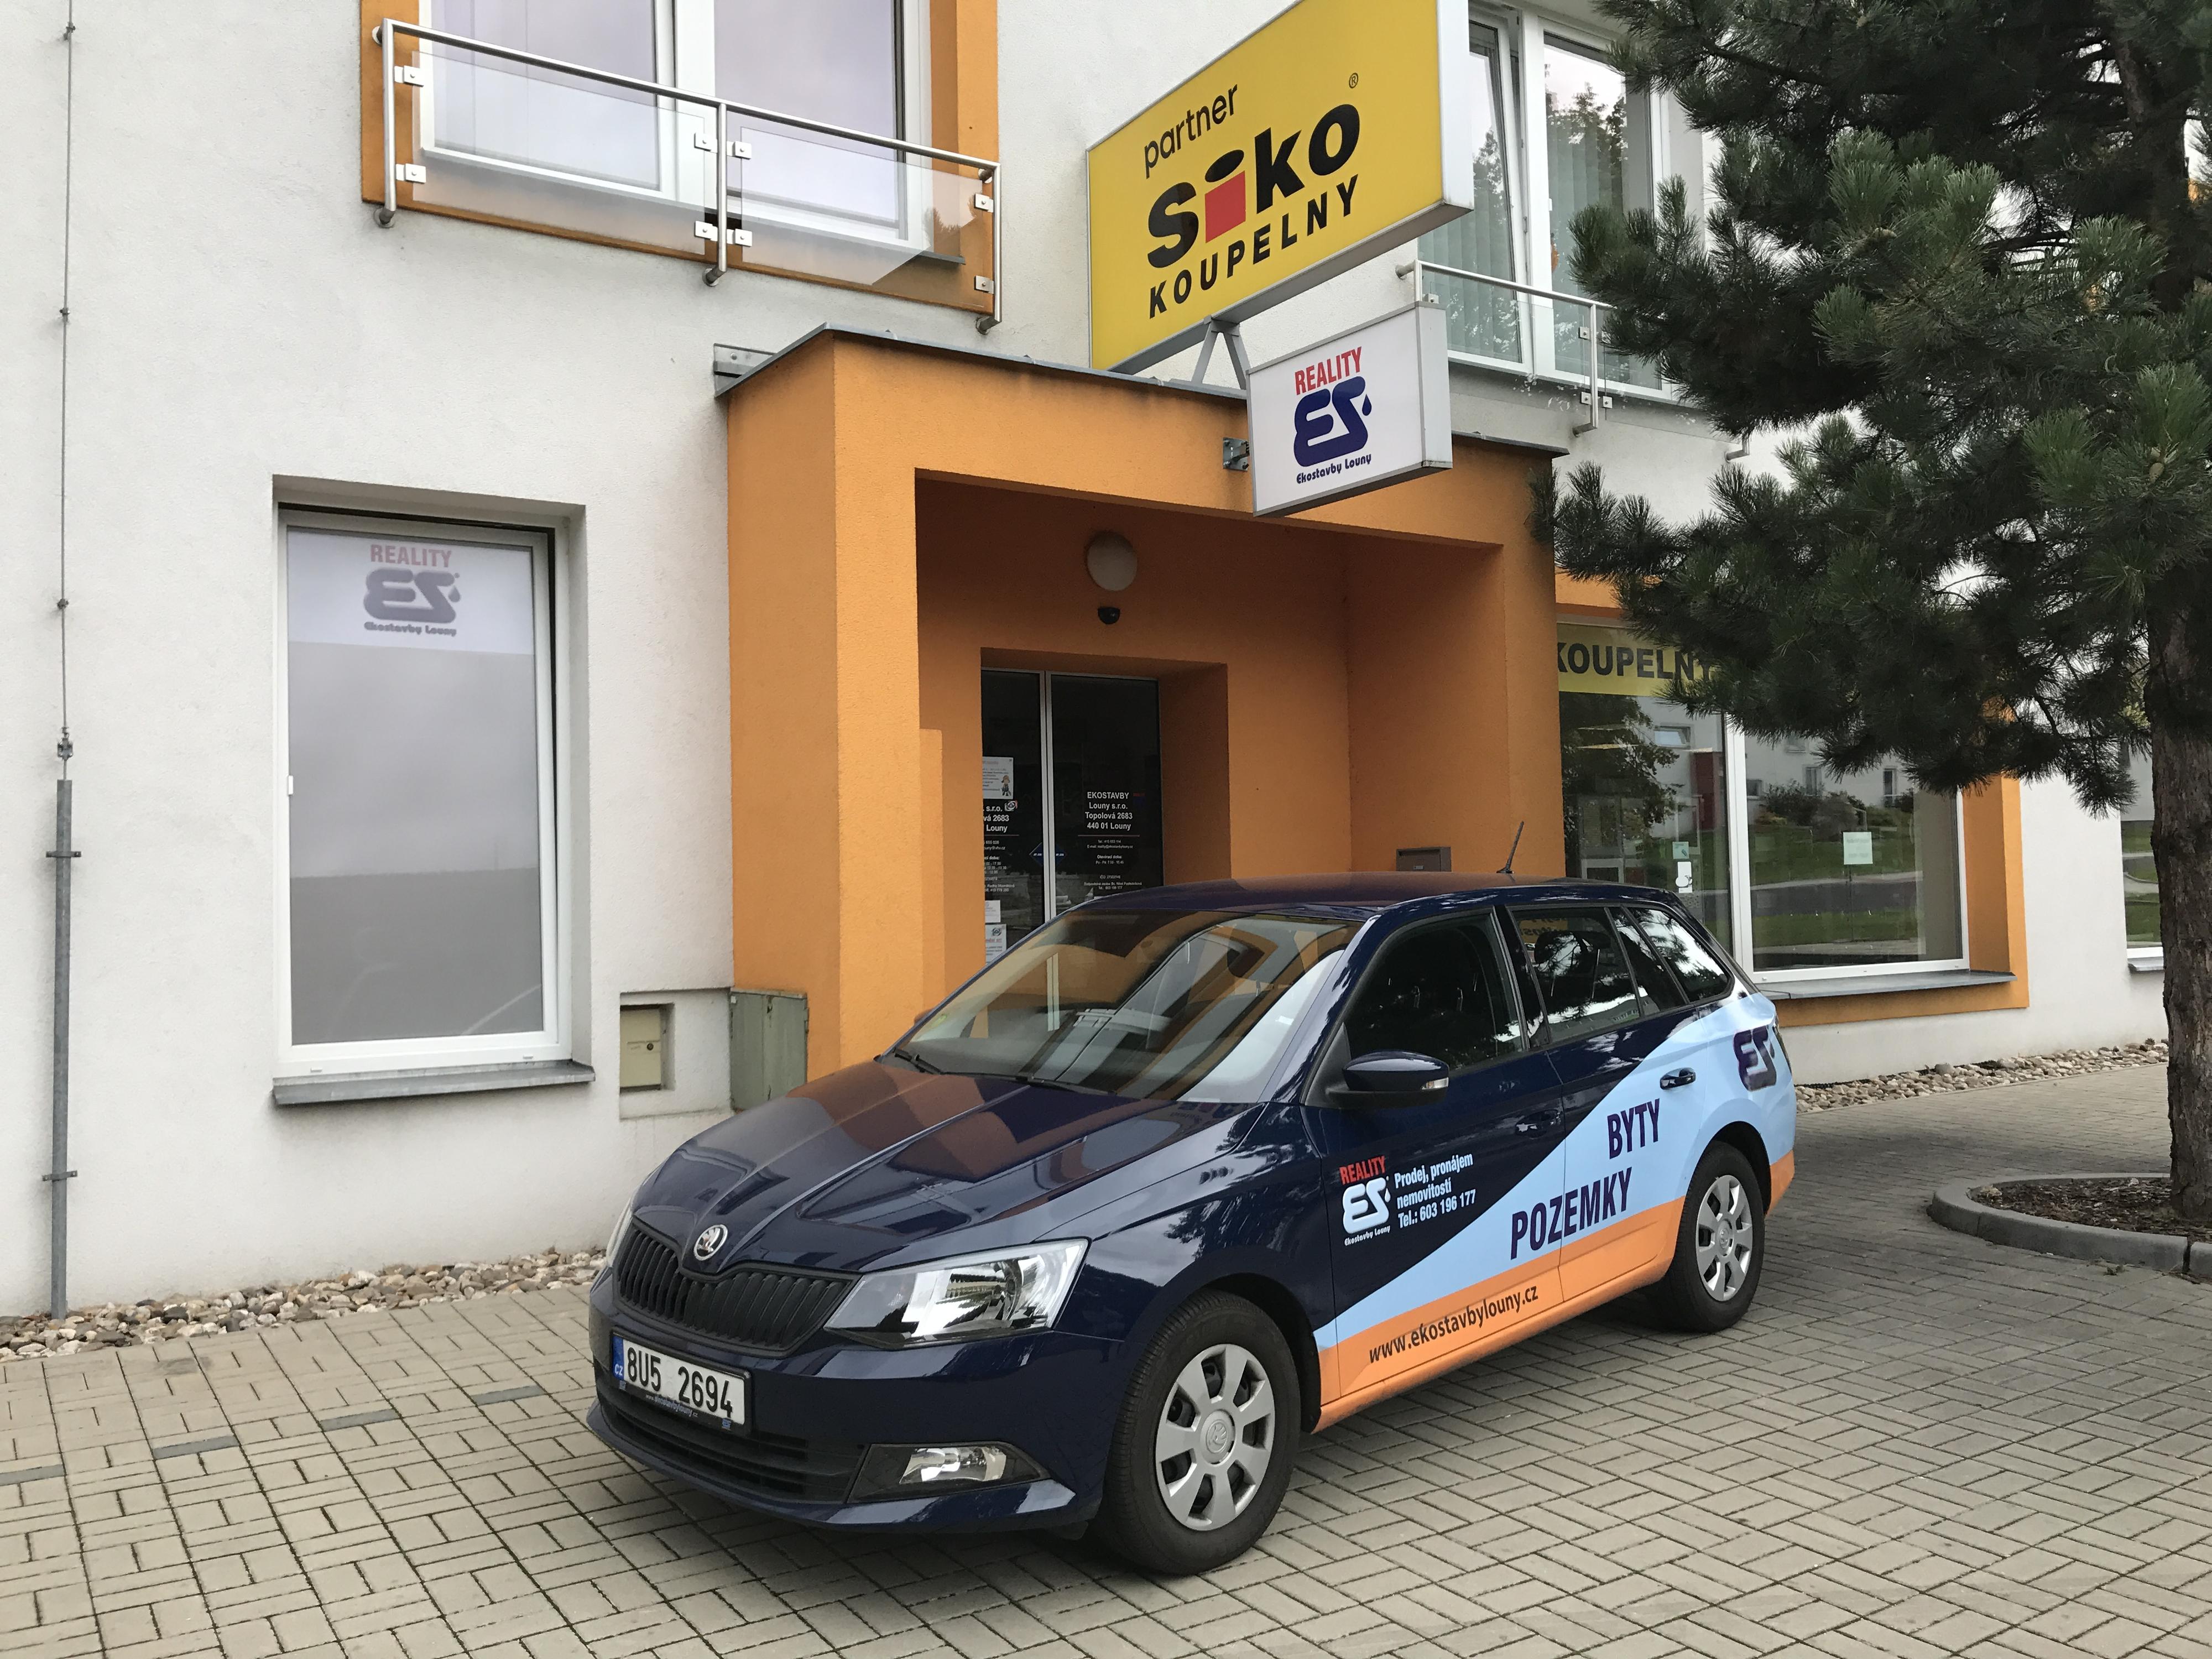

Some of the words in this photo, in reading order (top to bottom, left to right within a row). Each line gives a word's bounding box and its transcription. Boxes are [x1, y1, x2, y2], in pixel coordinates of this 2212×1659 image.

[1144, 85, 1238, 178] partner
[1149, 174, 1359, 319] KOUPELNY
[1295, 347, 1361, 395] REALITY
[1296, 463, 1342, 484] Ekostavby
[1345, 454, 1372, 469] Louny
[371, 544, 452, 567] REALITY
[1084, 811, 1115, 820] Topolová
[1089, 802, 1110, 811] Louny
[986, 825, 1008, 833] Louny
[1110, 822, 1131, 831] Louny
[1608, 1098, 1660, 1160] BYTY
[1339, 1155, 1385, 1185] REALITY
[1394, 1165, 1428, 1188] Prodej,
[1431, 1154, 1473, 1181] pronájem
[1397, 1177, 1452, 1209] nemovitostí
[1398, 1209, 1418, 1228] Tel.:
[1420, 1203, 1438, 1222] 603
[1439, 1196, 1457, 1214] 196
[1459, 1189, 1476, 1207] 177
[1511, 1167, 1632, 1260] POZEMKY
[1344, 1232, 1373, 1246] Ekostavby
[1375, 1225, 1391, 1236] Louny
[1369, 1286, 1538, 1364] www.ekostavbylouny.cz
[614, 1363, 623, 1376] CZ
[627, 1347, 661, 1392] 8U5
[678, 1366, 733, 1418] 2694
